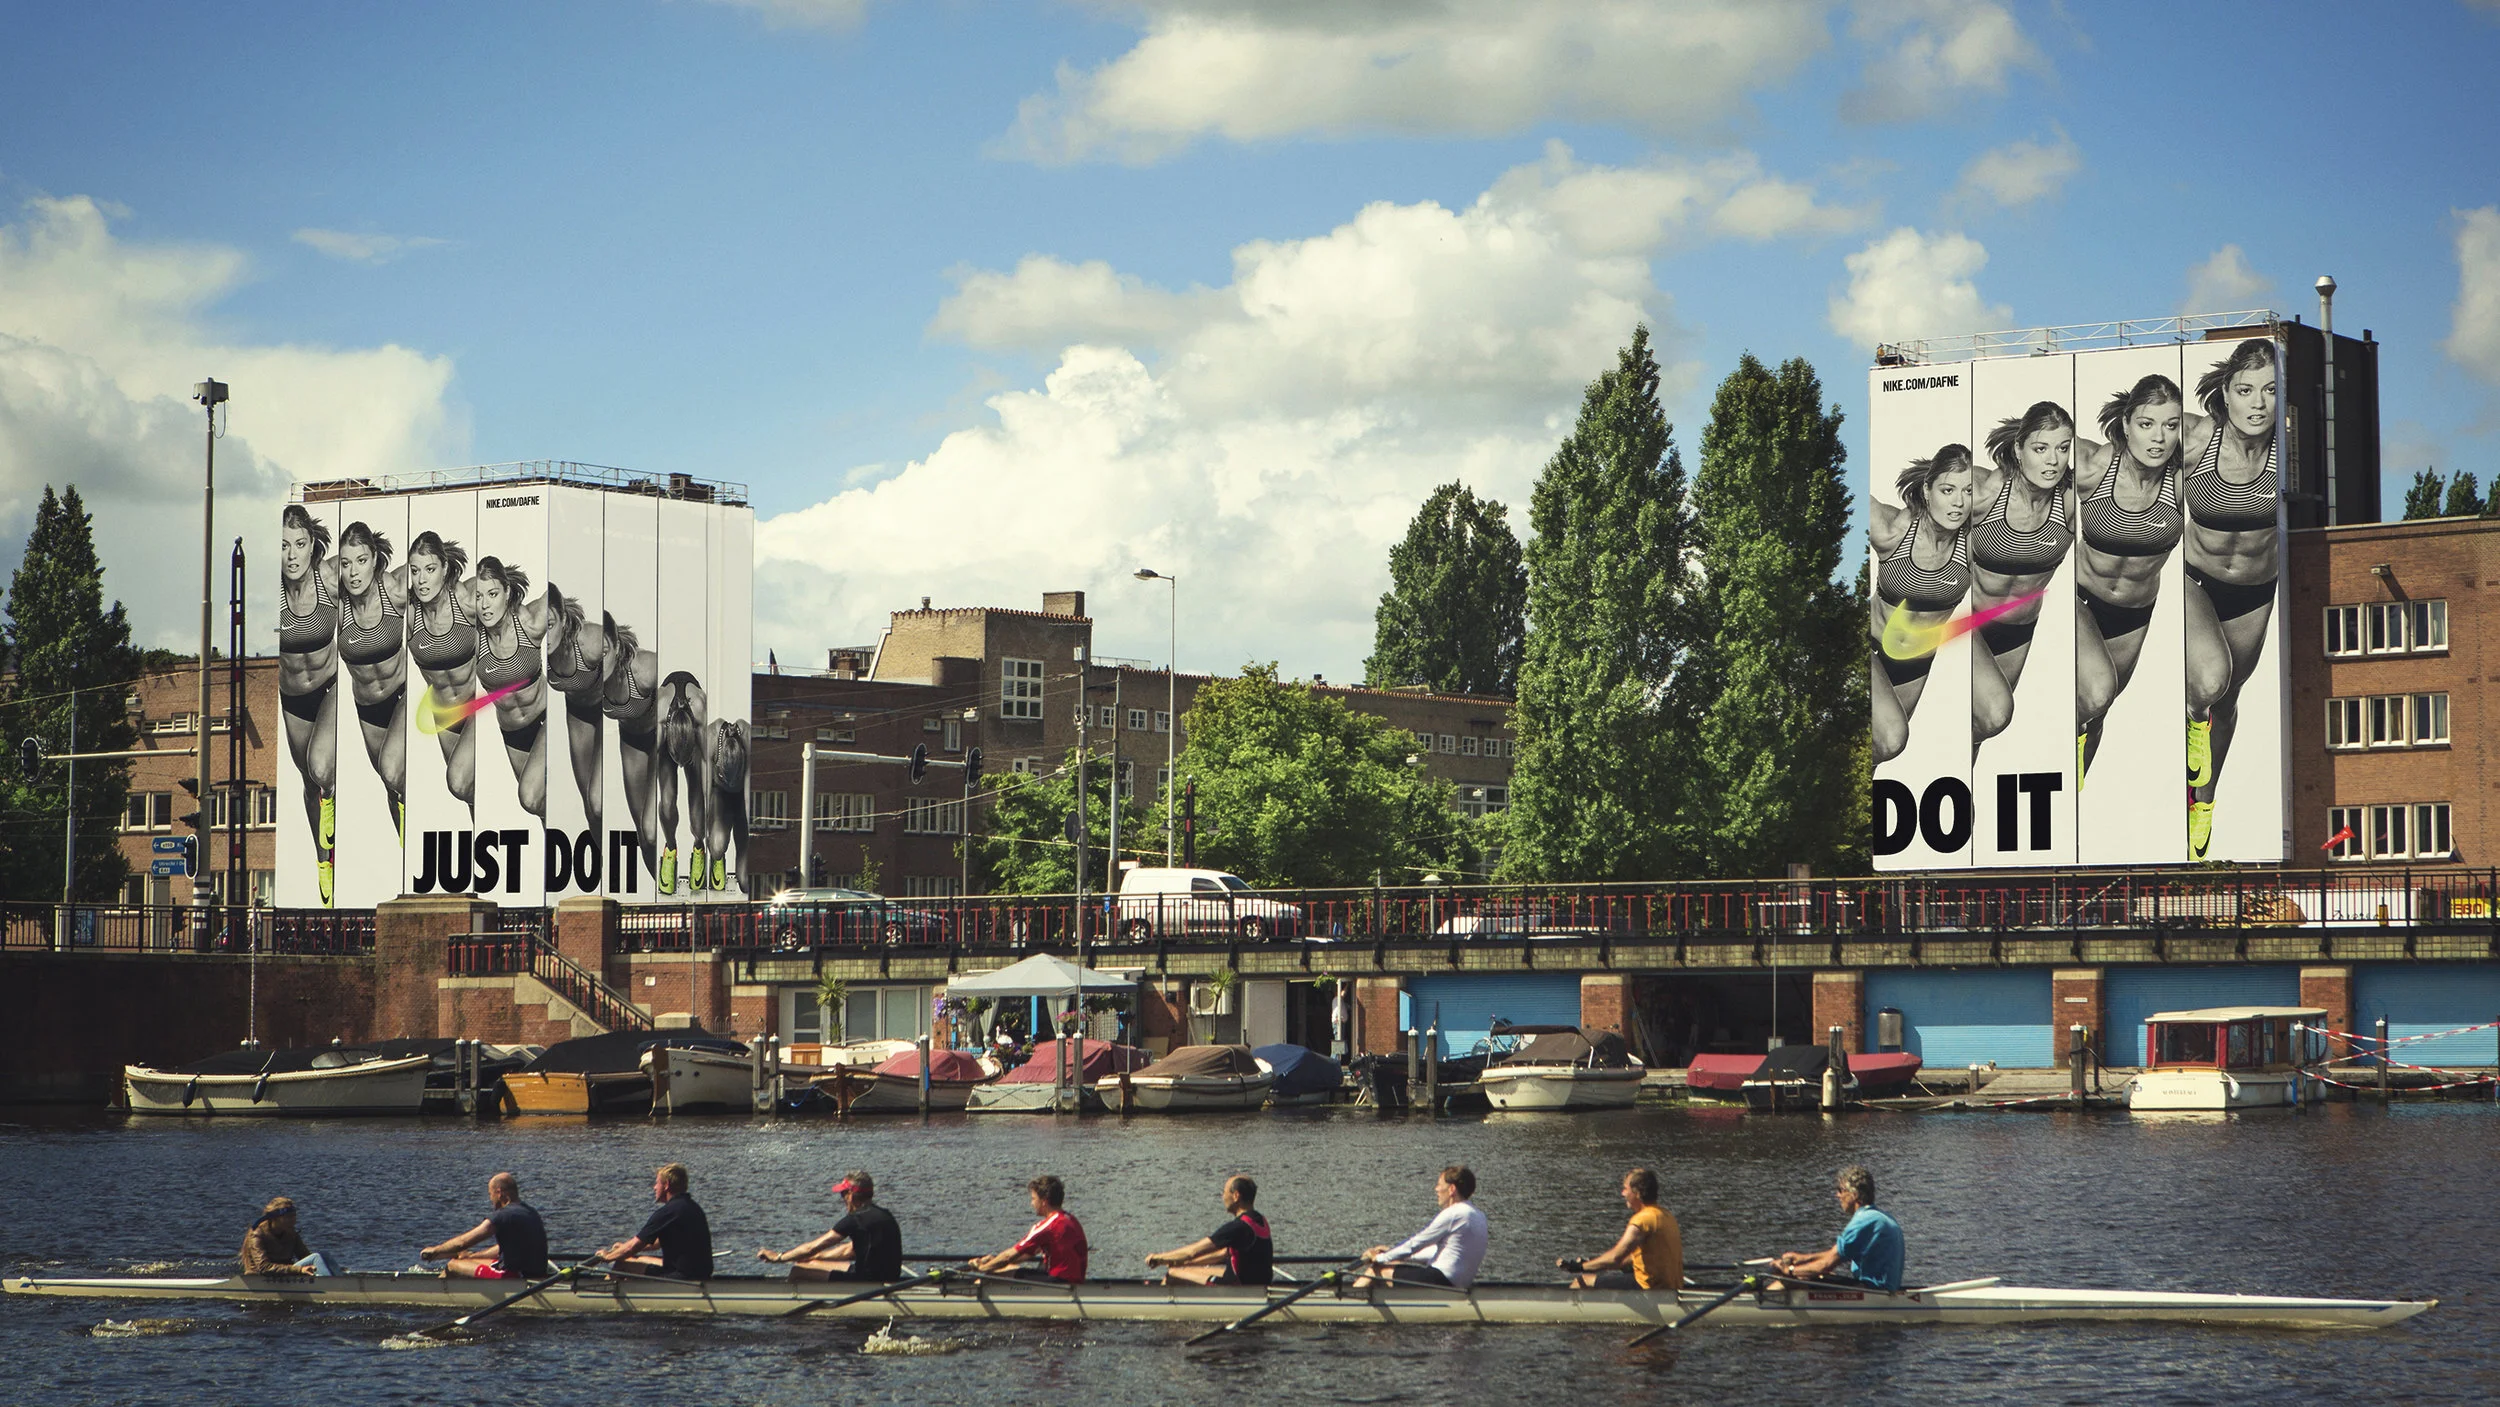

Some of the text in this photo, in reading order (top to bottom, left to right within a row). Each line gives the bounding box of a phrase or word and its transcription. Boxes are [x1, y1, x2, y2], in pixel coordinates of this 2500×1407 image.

[1883, 375, 1959, 392] NIKE.COM/DAFNE
[486, 495, 540, 509] NIKE.COM/DAFNE
[1873, 772, 2063, 854] DO IT
[413, 828, 641, 894] JUST DO IT
